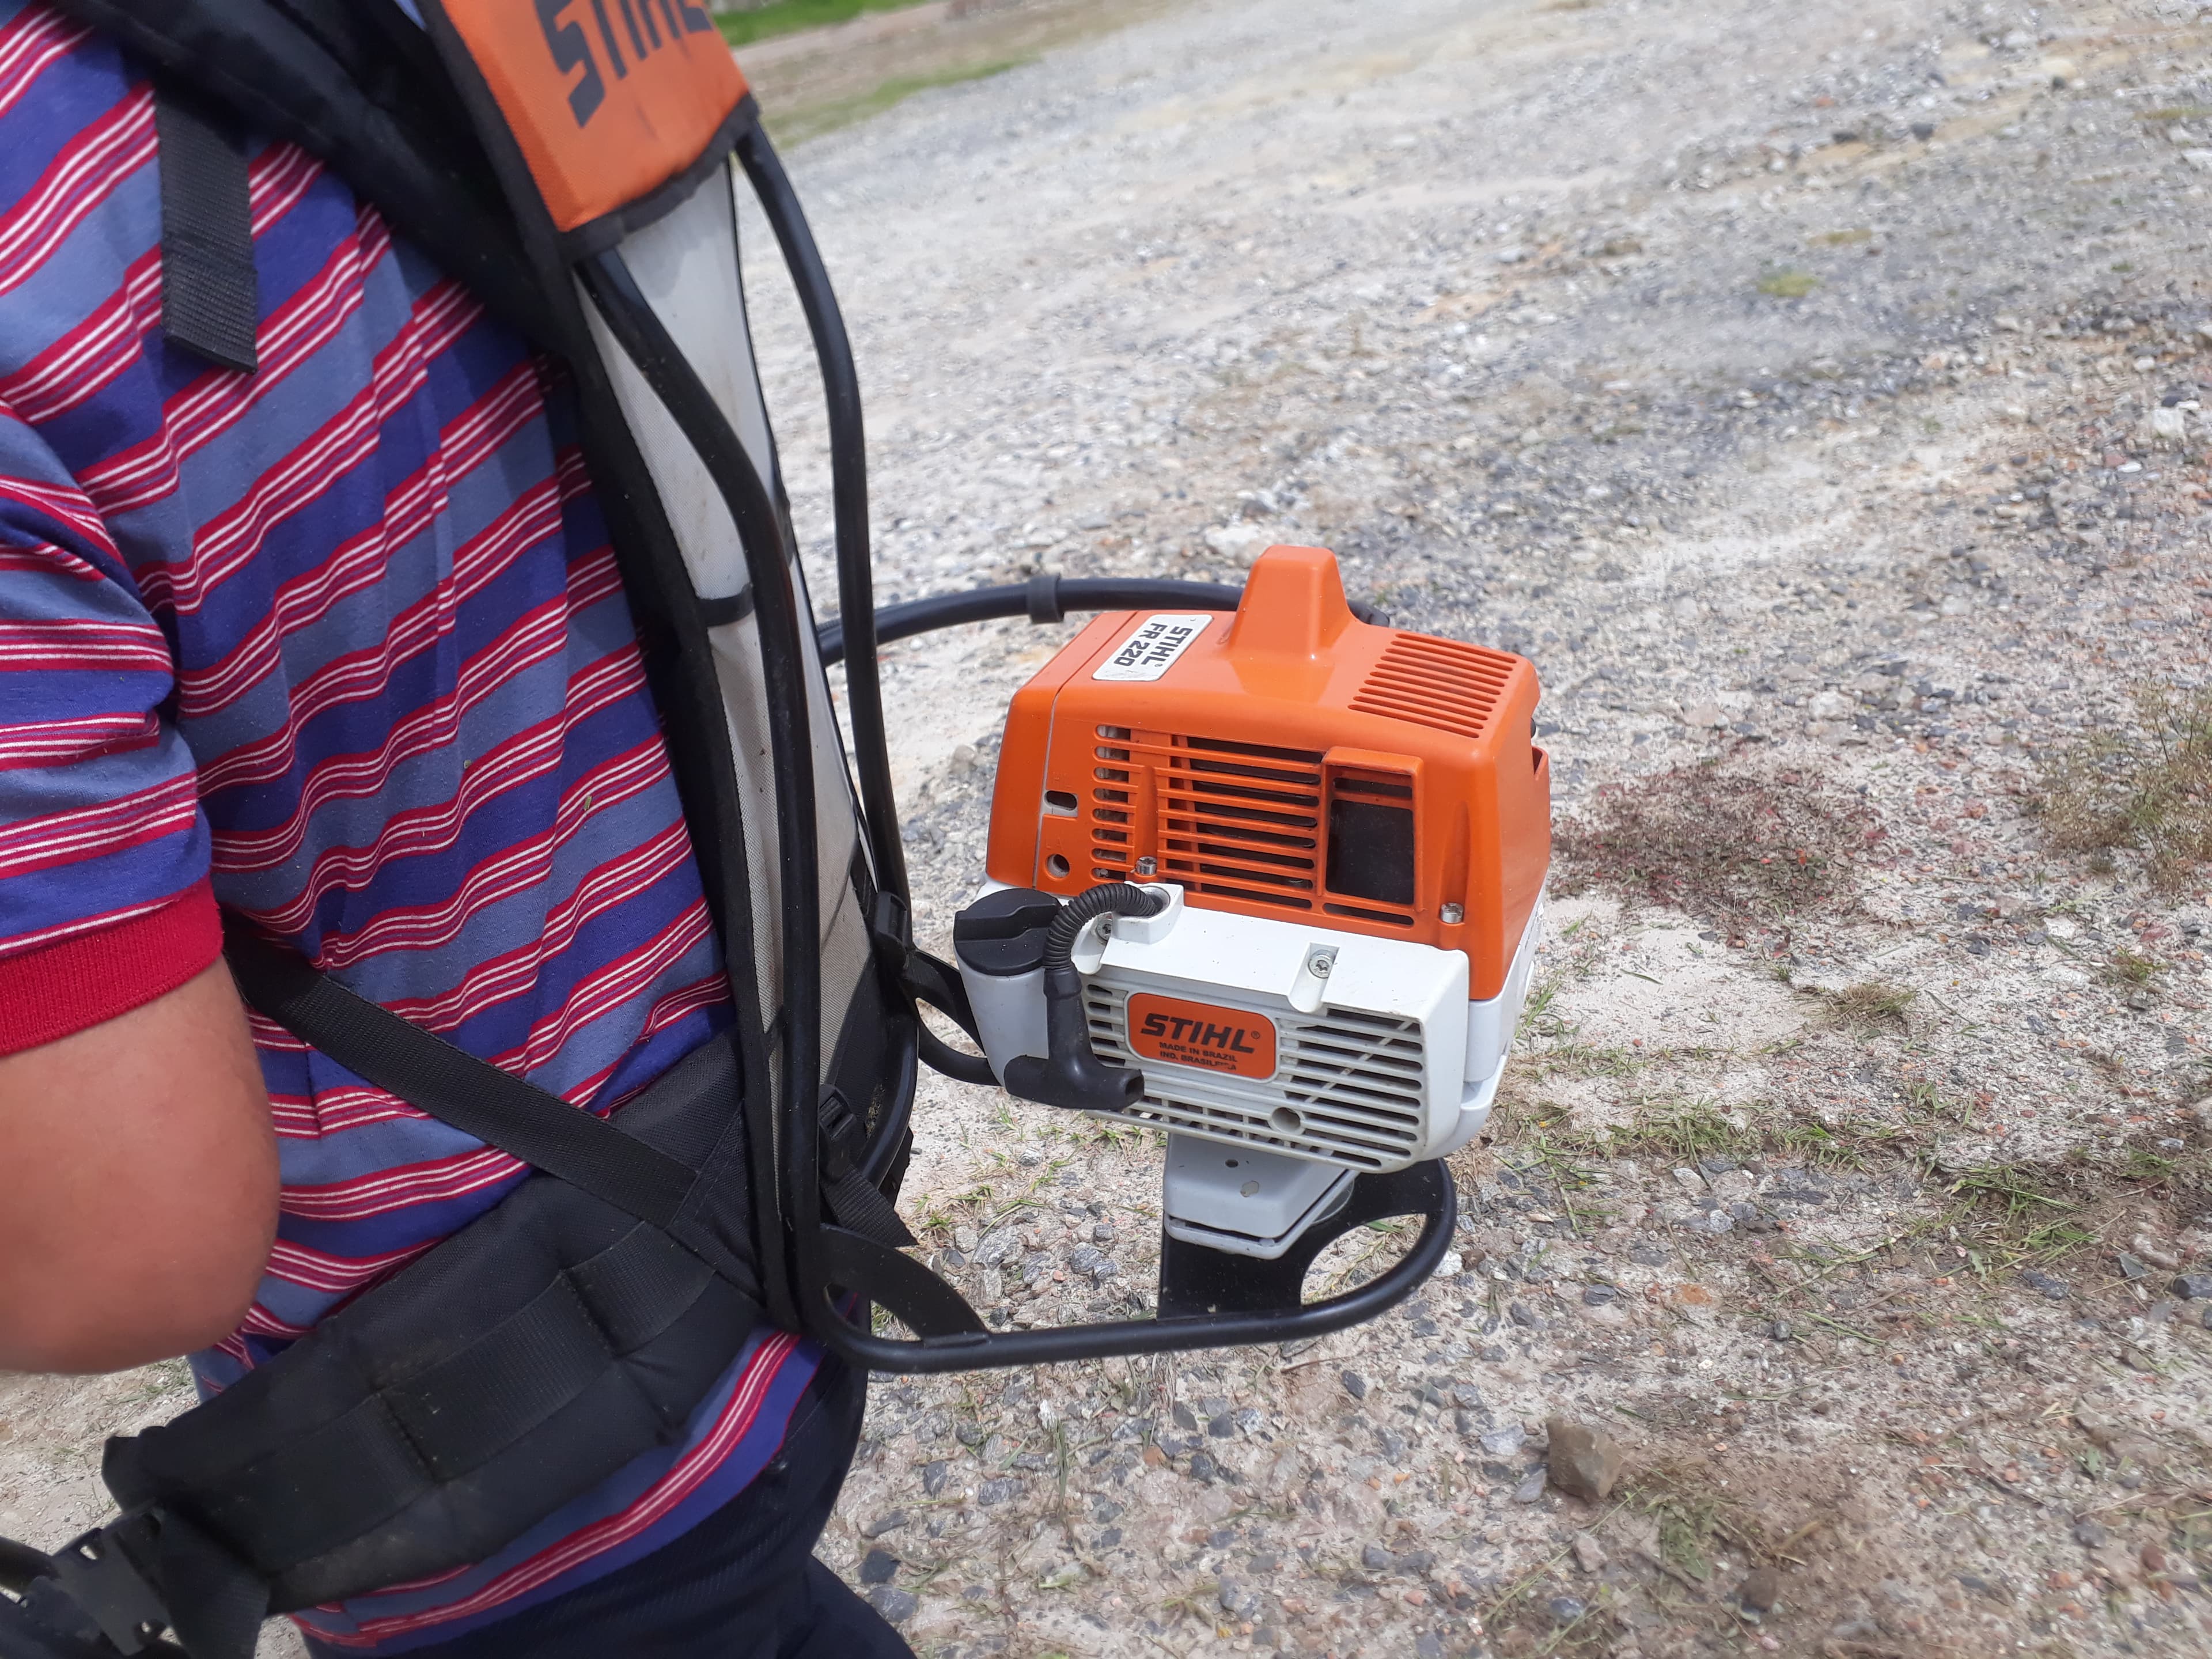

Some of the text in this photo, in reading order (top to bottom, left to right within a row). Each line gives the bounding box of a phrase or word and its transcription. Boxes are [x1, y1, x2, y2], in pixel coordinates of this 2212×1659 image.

[1113, 623, 1168, 666] FR 220
[1141, 626, 1194, 665] STIHL
[1141, 1013, 1255, 1054] STIHL
[1159, 1041, 1238, 1062] MADE IN BRAZIL
[1160, 1051, 1237, 1071] IND. BRASILEA
